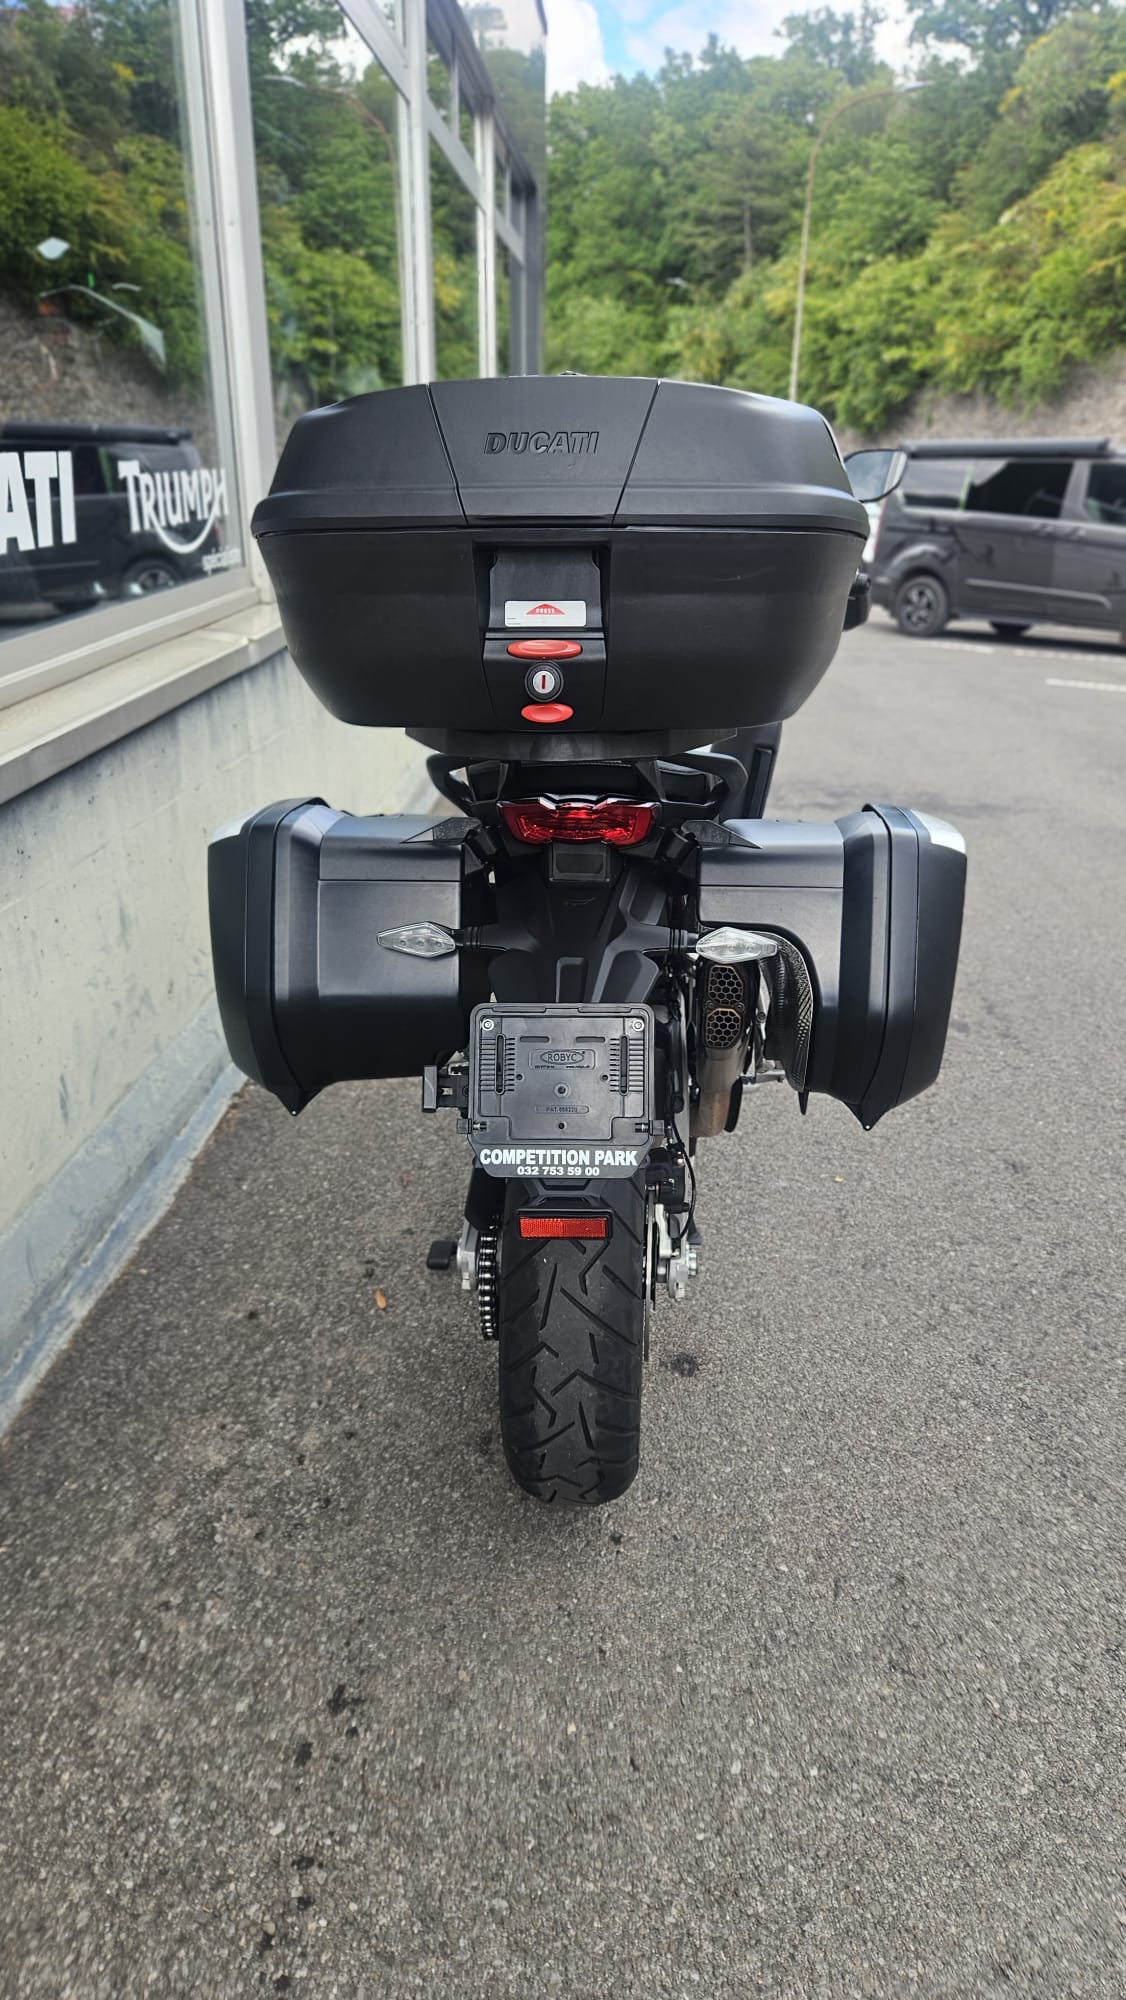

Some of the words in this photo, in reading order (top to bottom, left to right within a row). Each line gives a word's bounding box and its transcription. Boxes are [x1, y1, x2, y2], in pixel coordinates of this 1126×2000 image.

[484, 431, 600, 455] DUCATI
[547, 1053, 577, 1062] ROBYC
[480, 1149, 591, 1165] COMPETITION
[594, 1150, 638, 1166] PARK
[517, 1166, 539, 1176] 032
[542, 1166, 564, 1176] 753
[567, 1166, 582, 1176] 59
[585, 1166, 600, 1176] 00
